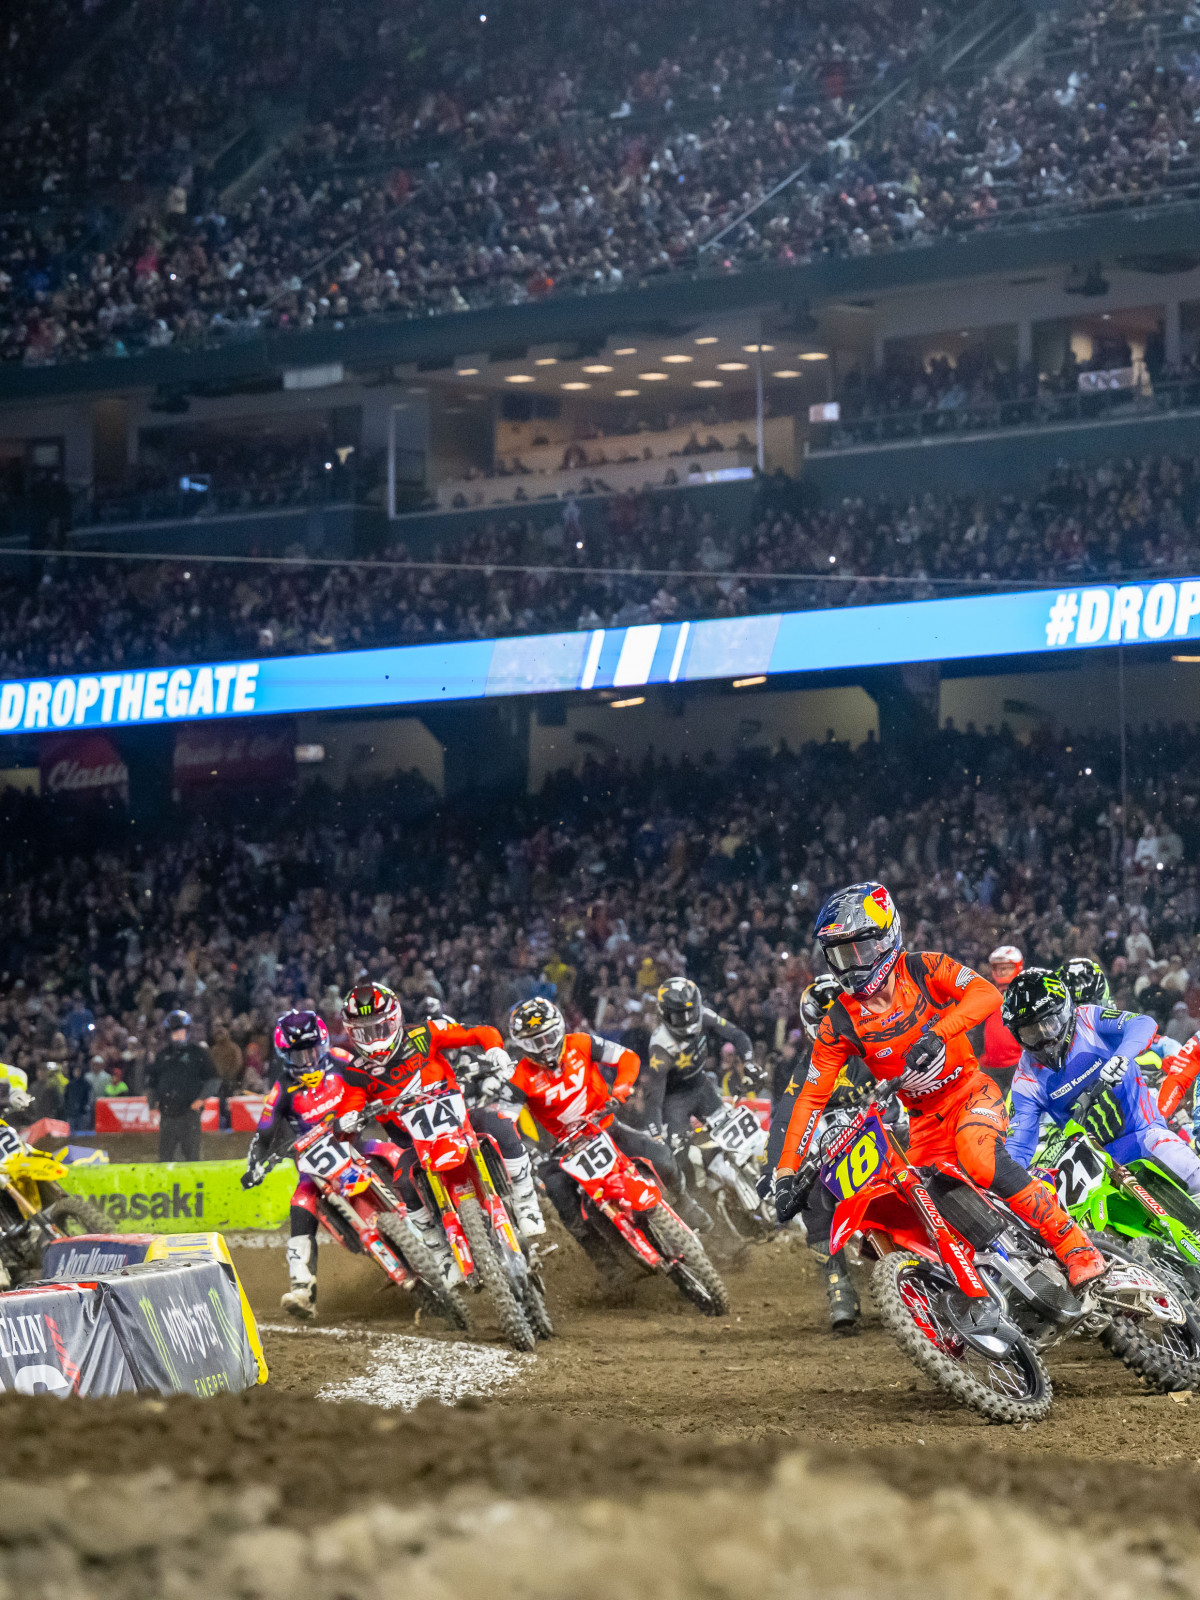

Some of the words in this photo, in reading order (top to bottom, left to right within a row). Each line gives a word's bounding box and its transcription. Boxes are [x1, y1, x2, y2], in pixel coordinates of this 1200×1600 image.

[545, 1066, 585, 1106] FLY
[903, 1066, 963, 1098] HONDA
[1051, 1085, 1070, 1098] AIROH
[1071, 1058, 1103, 1086] Kawasaki
[411, 1094, 464, 1140] 14
[722, 1111, 760, 1150] 28
[305, 1137, 350, 1176] 51
[576, 1140, 614, 1179] 15
[835, 1131, 880, 1200] 18
[1055, 1140, 1103, 1207] 21
[949, 1243, 983, 1290] DUNLOP
